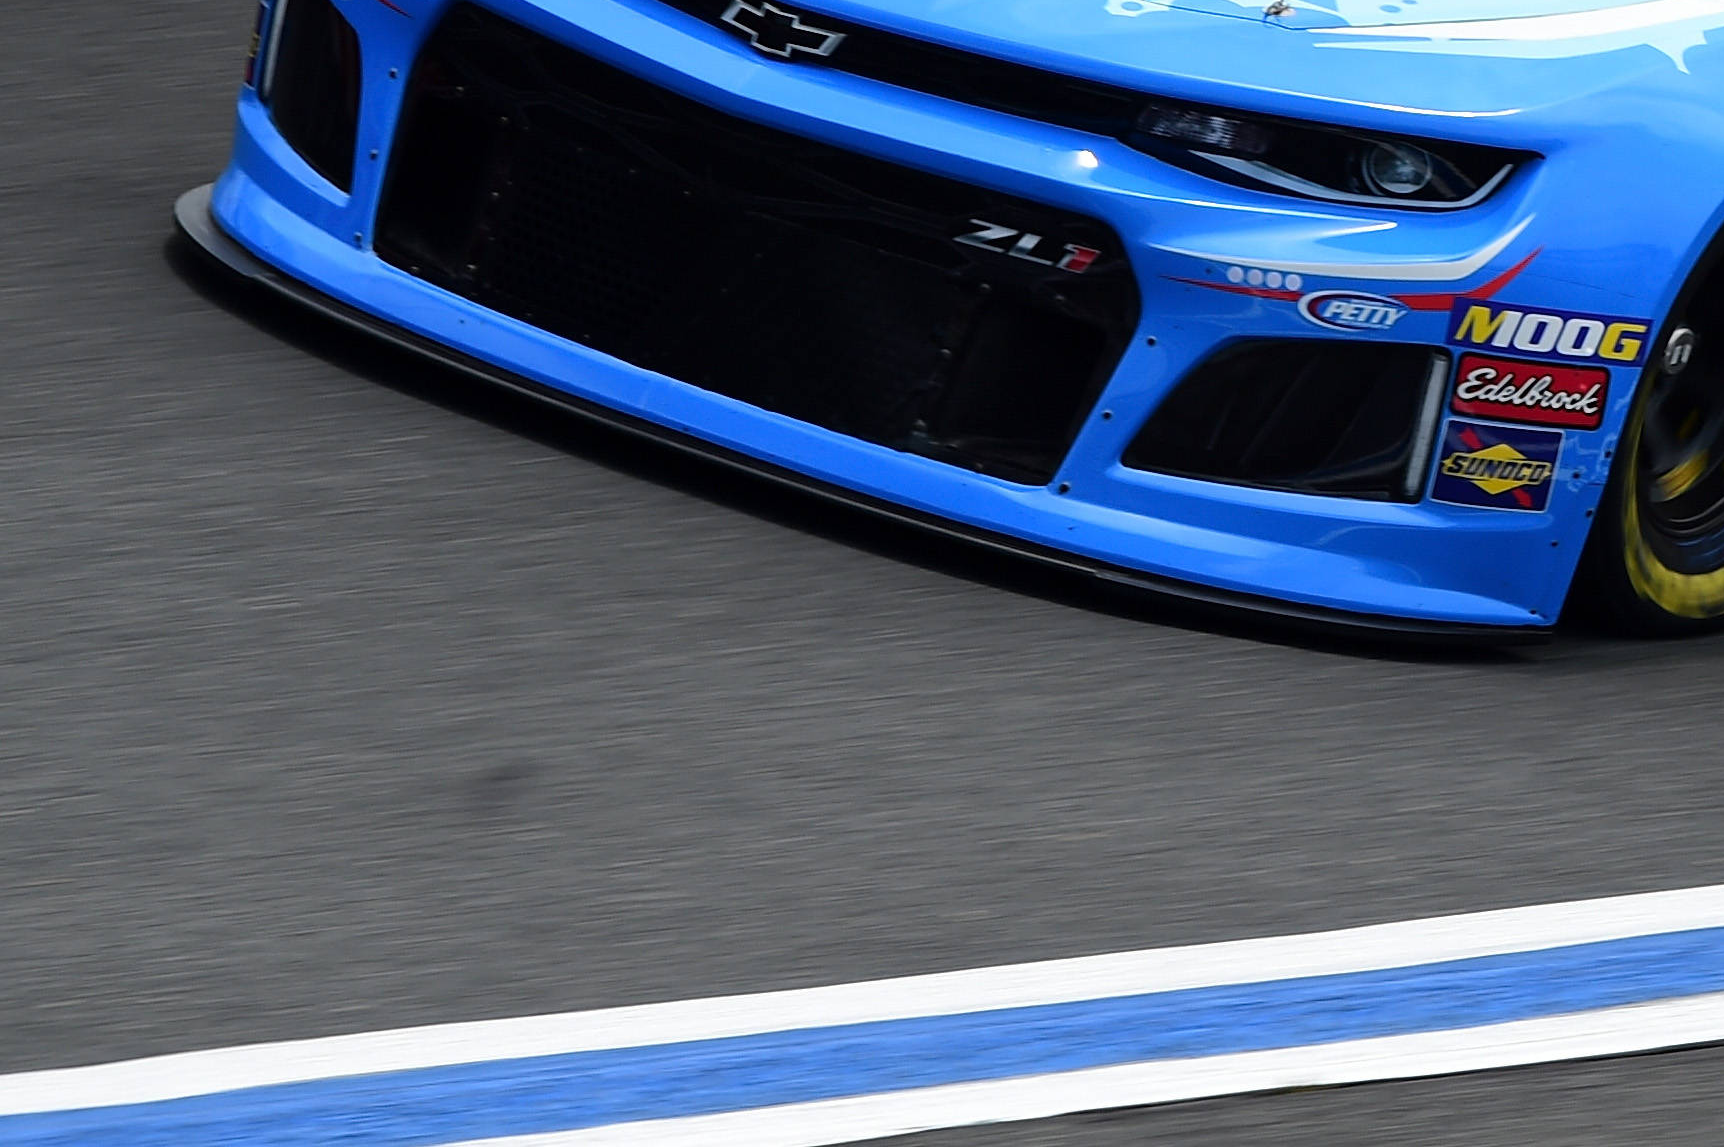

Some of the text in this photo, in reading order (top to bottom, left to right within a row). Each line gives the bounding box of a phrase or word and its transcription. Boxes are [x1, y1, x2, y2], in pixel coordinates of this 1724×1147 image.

[952, 218, 1102, 274] ZL1
[1323, 301, 1408, 325] PETTY
[1454, 306, 1648, 362] MOOG
[1457, 367, 1601, 414] Edelbrock
[1449, 454, 1547, 483] SUNOCO
